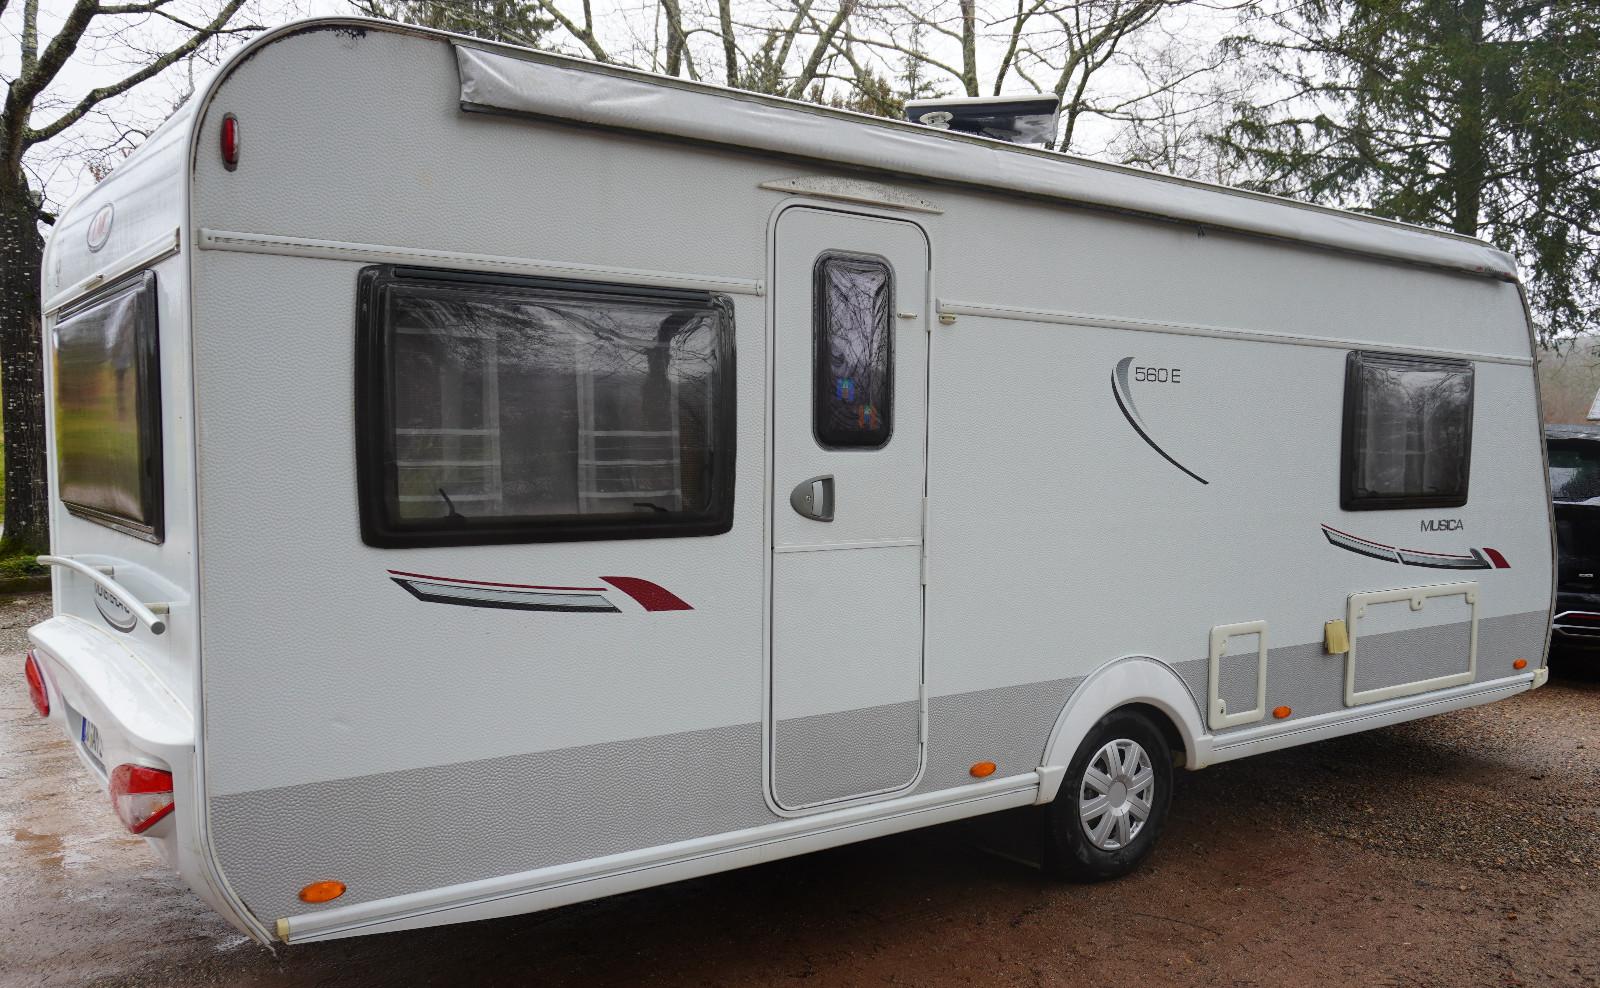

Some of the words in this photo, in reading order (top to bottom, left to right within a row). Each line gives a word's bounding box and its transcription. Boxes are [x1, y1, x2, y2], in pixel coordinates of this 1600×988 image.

[1135, 367, 1168, 382] 560
[1171, 369, 1181, 383] E
[1420, 519, 1464, 532] MUSICA
